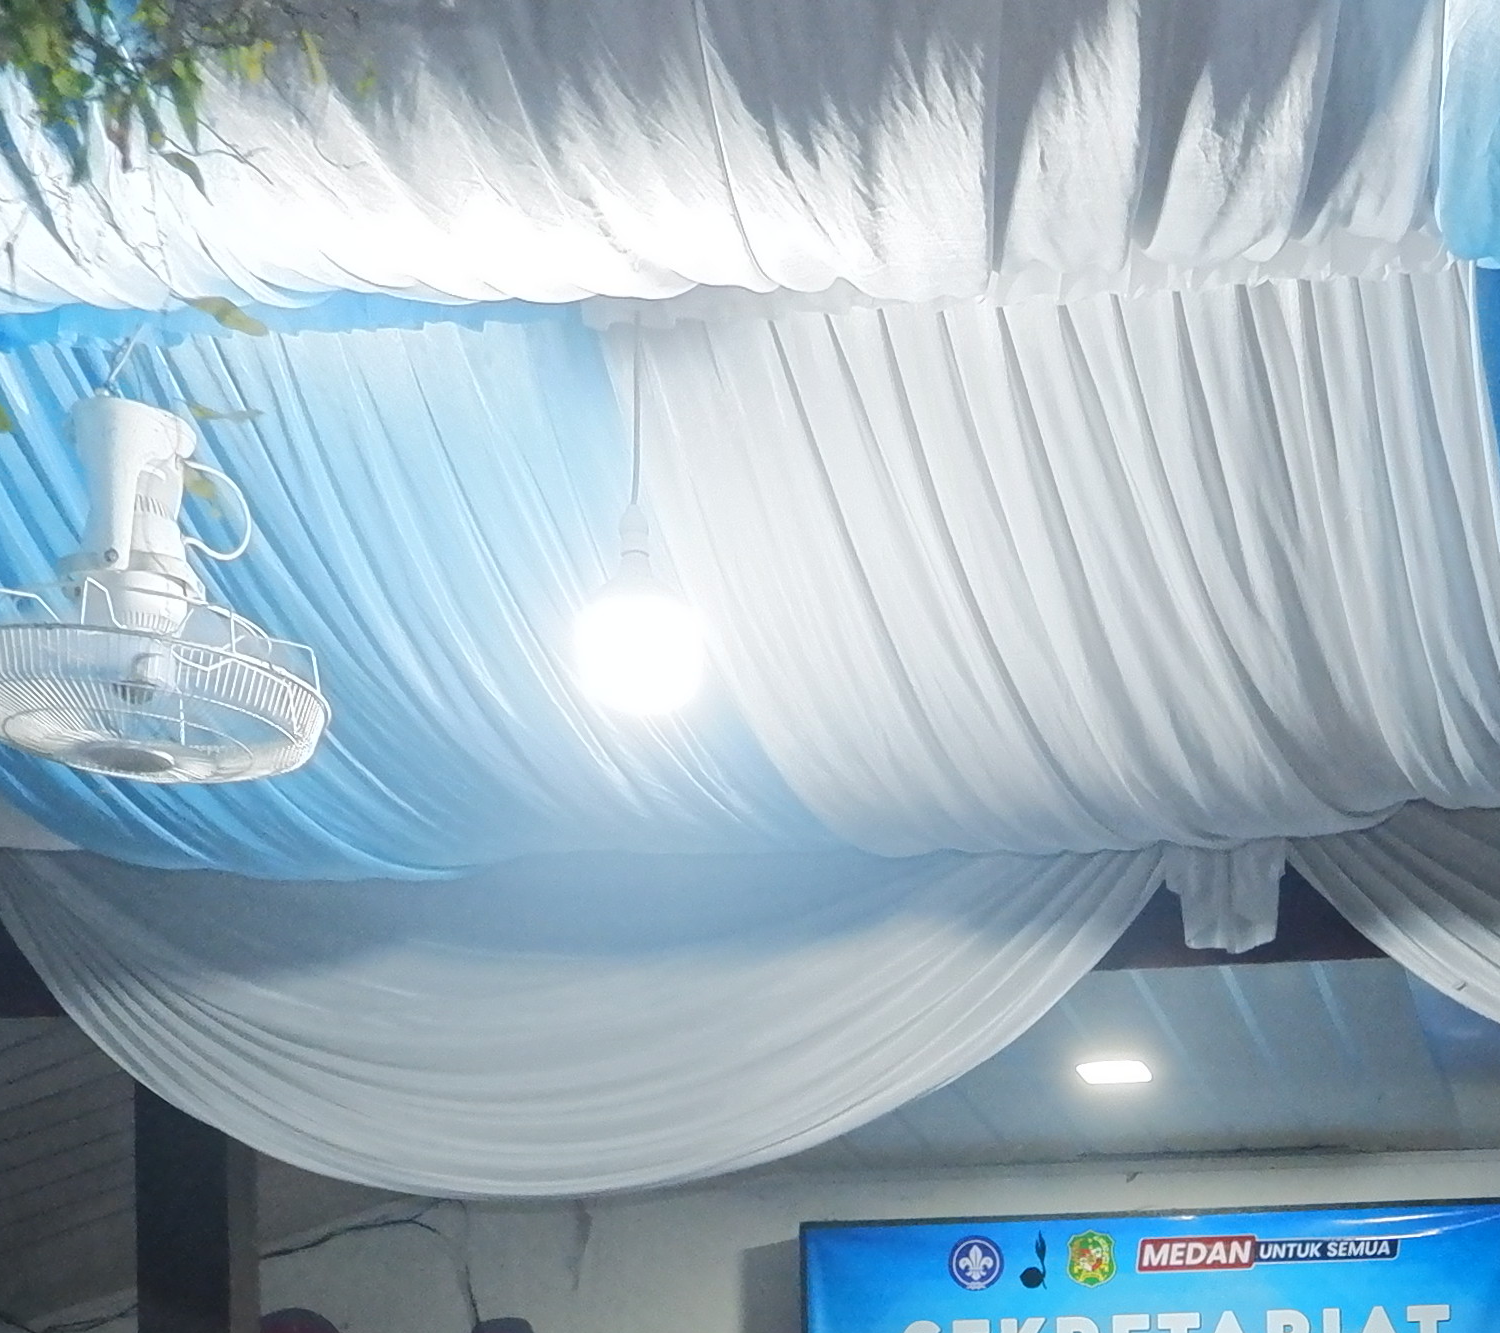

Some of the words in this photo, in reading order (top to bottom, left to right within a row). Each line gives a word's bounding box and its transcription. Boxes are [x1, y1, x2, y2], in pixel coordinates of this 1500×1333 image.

[1142, 1239, 1252, 1267] MEDAN
[1258, 1243, 1321, 1260] UNTUK
[1325, 1240, 1391, 1258] SEMUA
